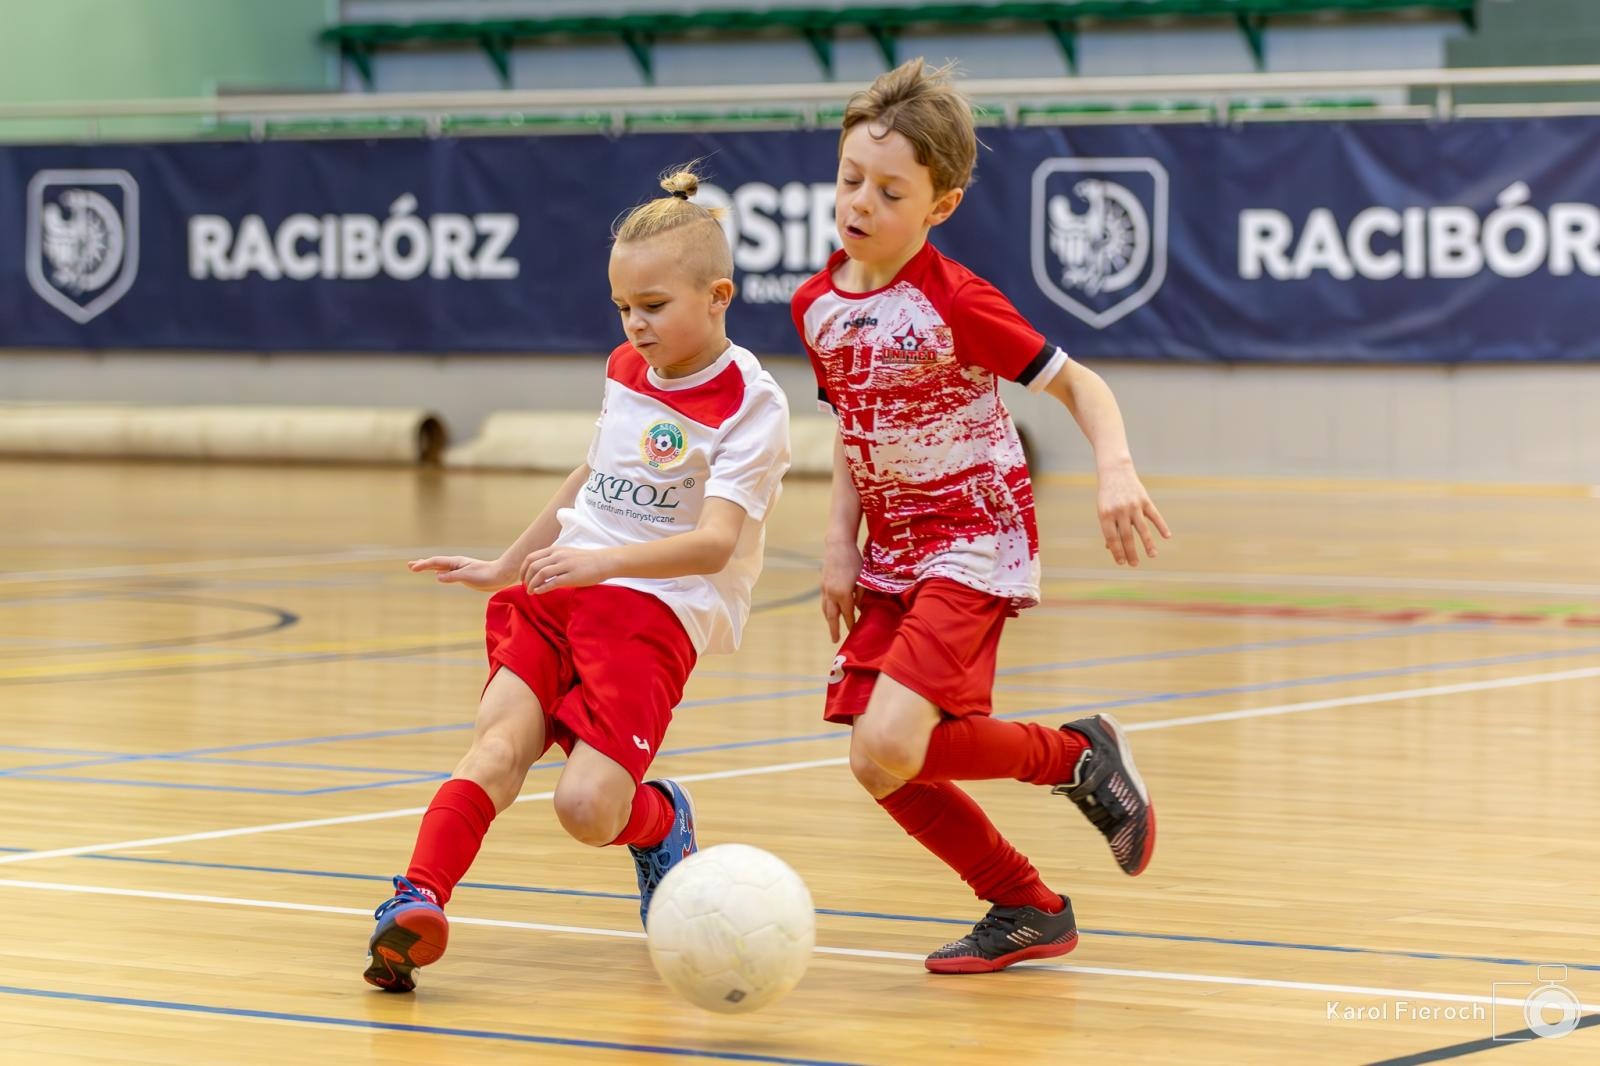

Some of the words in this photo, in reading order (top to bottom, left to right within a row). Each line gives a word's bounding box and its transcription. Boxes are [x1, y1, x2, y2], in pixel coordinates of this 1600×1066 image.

[188, 193, 519, 279] RACIBÓRZ
[1238, 181, 1600, 279] RACIBÓR
[882, 349, 937, 362] UNITED
[597, 501, 624, 515] Centrum
[625, 509, 675, 523] Florystyczne
